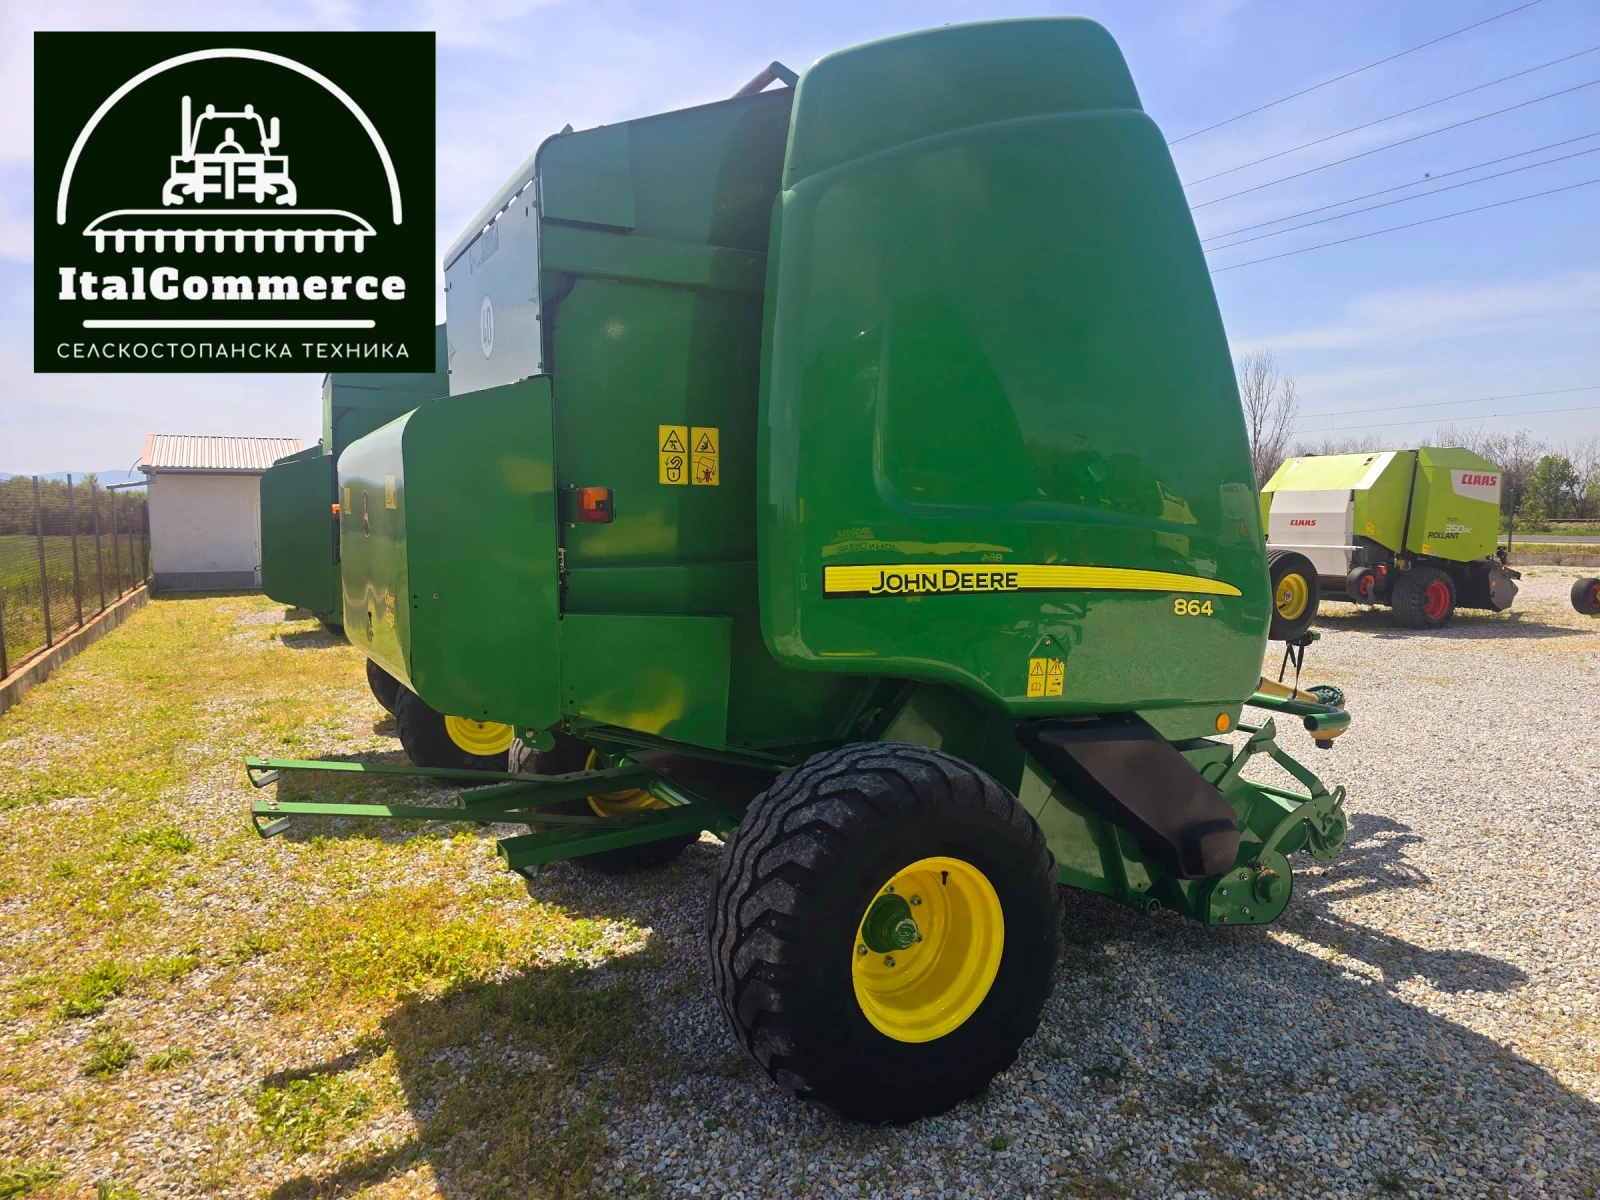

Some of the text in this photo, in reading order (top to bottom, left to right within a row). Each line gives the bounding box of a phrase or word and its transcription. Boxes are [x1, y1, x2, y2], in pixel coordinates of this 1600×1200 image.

[482, 305, 493, 347] 40
[1461, 474, 1497, 487] CLAAS
[1290, 519, 1316, 527] CLAAS
[1427, 531, 1460, 539] ROLLANT
[871, 569, 1019, 592] JOHN DEERE
[1173, 597, 1214, 617] 864
